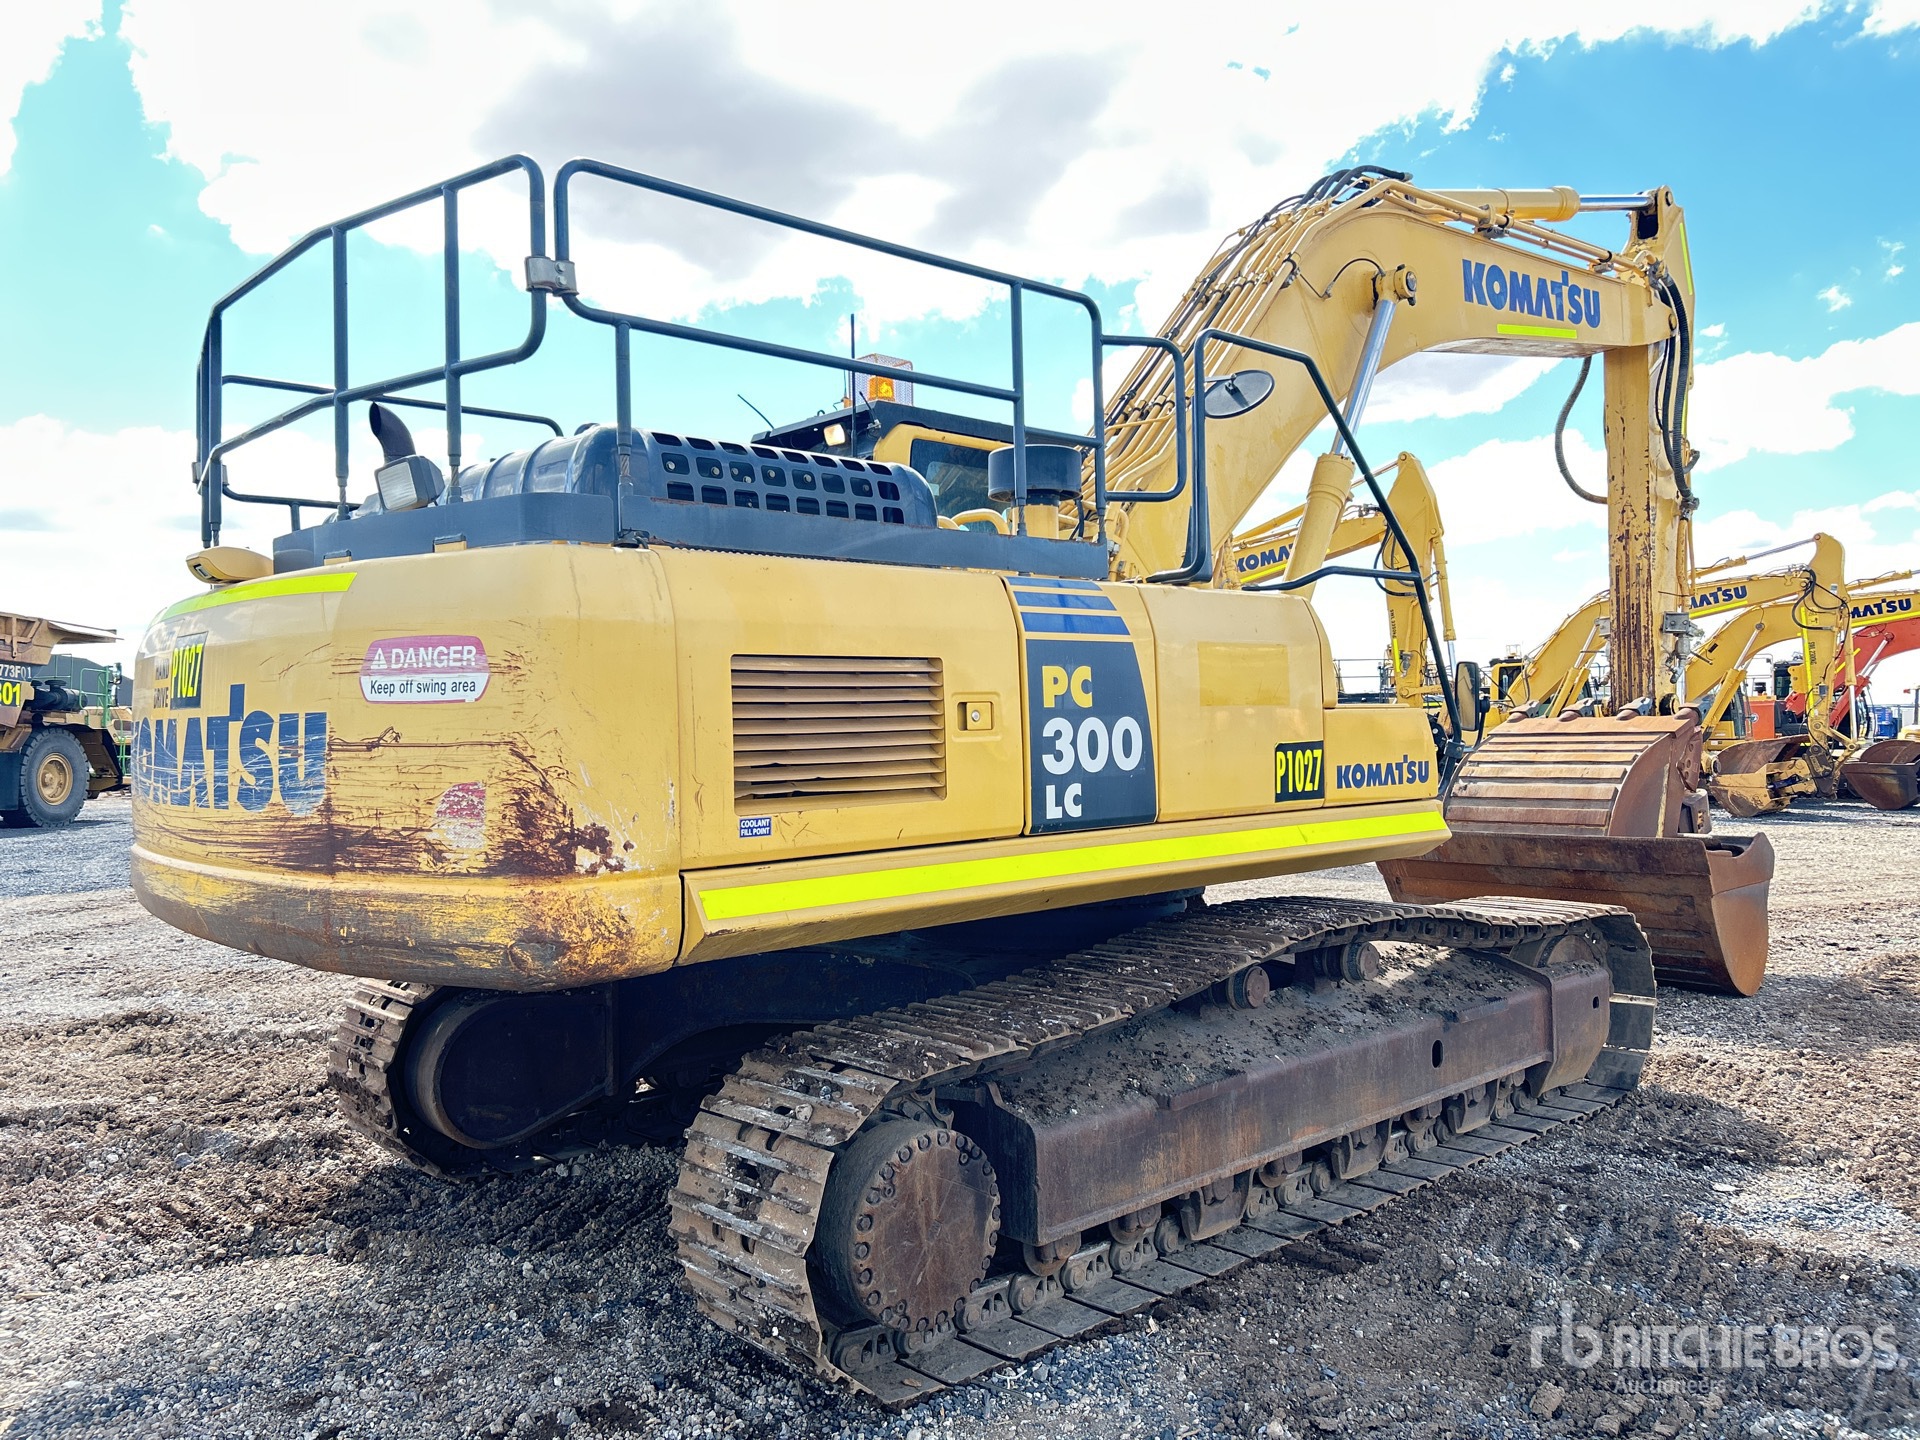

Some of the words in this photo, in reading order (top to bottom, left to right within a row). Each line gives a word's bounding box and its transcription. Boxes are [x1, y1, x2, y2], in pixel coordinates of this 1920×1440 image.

[1462, 259, 1601, 328] KOMATSU
[1237, 543, 1293, 572] KOMA
[171, 643, 204, 698] P1027
[391, 646, 477, 669] DANGER
[370, 680, 396, 697] Keep
[399, 679, 413, 693] off
[416, 679, 447, 695] swing
[451, 681, 476, 692] area
[1042, 666, 1093, 708] PC
[1042, 716, 1143, 775] 300
[1276, 749, 1322, 794] P1027
[1336, 754, 1429, 789] KOMATSU
[1046, 783, 1082, 819] LC
[740, 819, 770, 828] COOLANT
[753, 827, 770, 835] POINT
